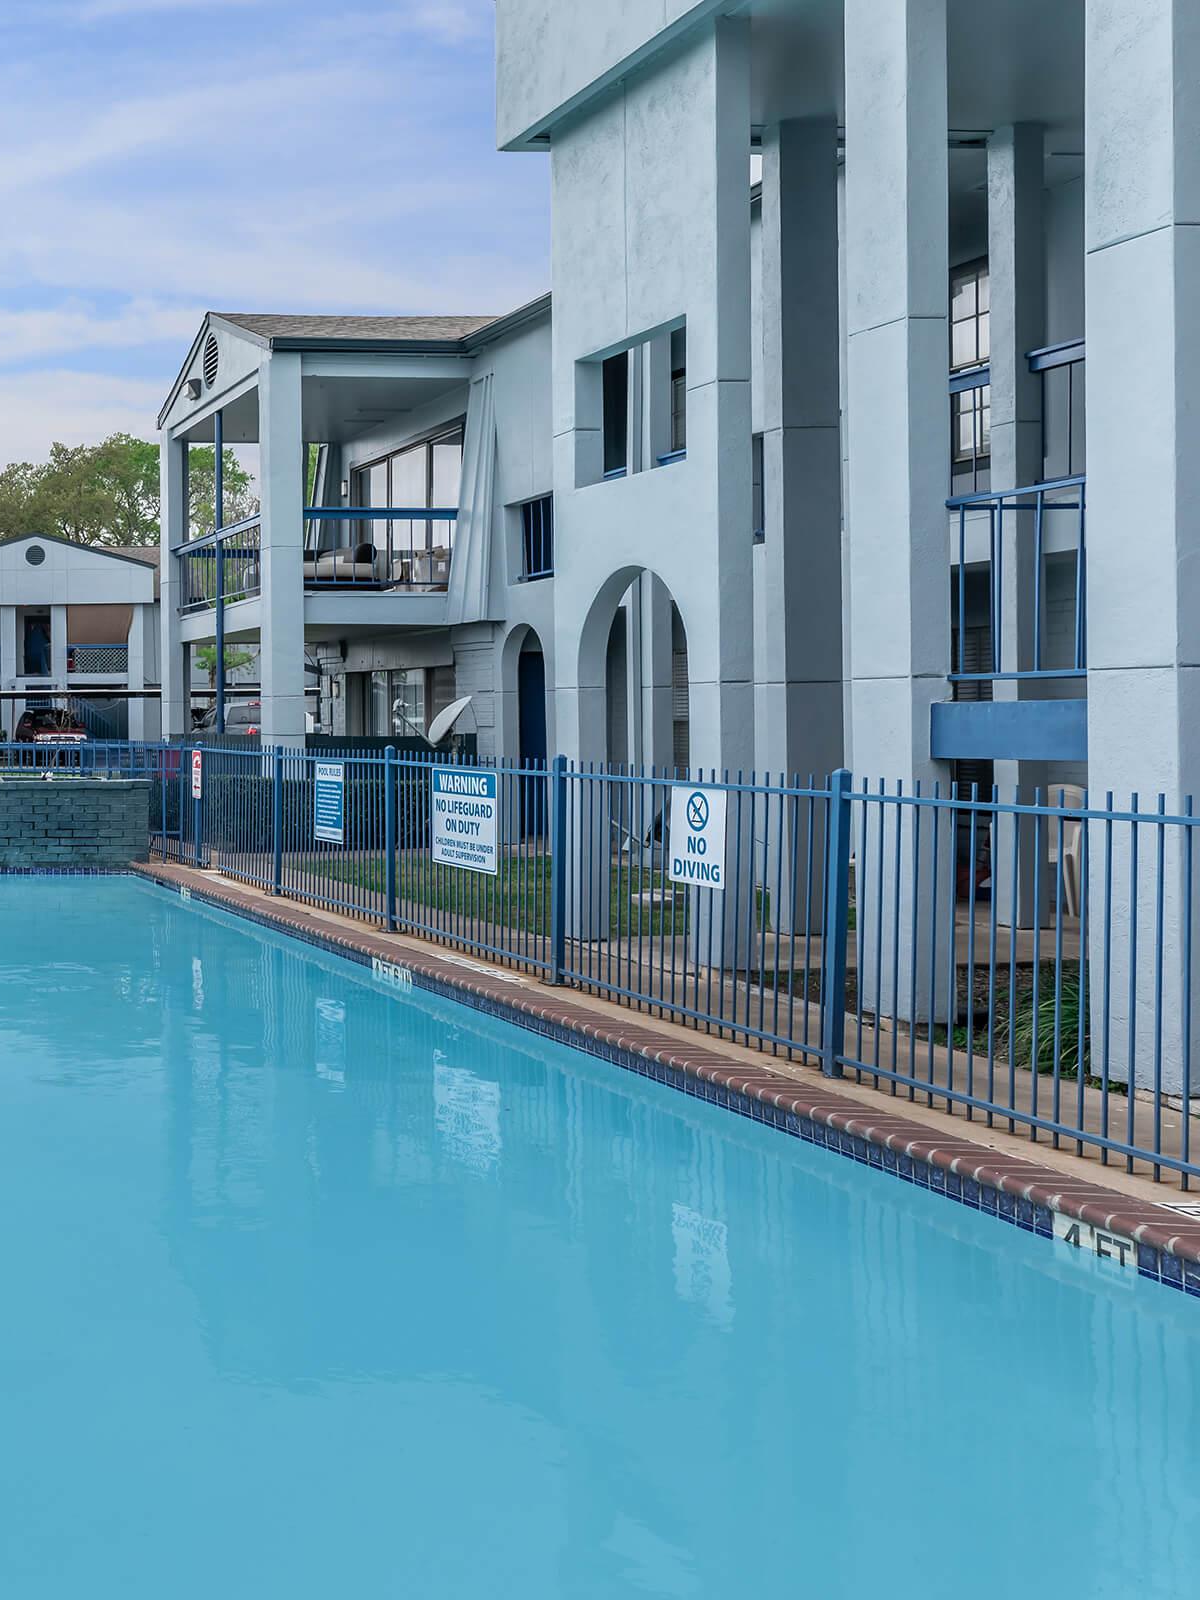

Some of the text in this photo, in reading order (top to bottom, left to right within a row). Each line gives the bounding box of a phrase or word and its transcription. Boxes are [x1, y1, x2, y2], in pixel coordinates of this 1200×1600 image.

[318, 767, 341, 777] POOL RULES
[439, 773, 488, 796] WARNING
[435, 798, 493, 819] NO LIFEGUARD
[445, 818, 480, 836] ON DUTY
[435, 836, 494, 855] CHILDREN MUST BE UNDER
[687, 836, 707, 855] NO
[441, 847, 486, 864] ADULT SUPERVISION
[673, 858, 720, 883] DIVING
[1096, 1232, 1132, 1268] FT
